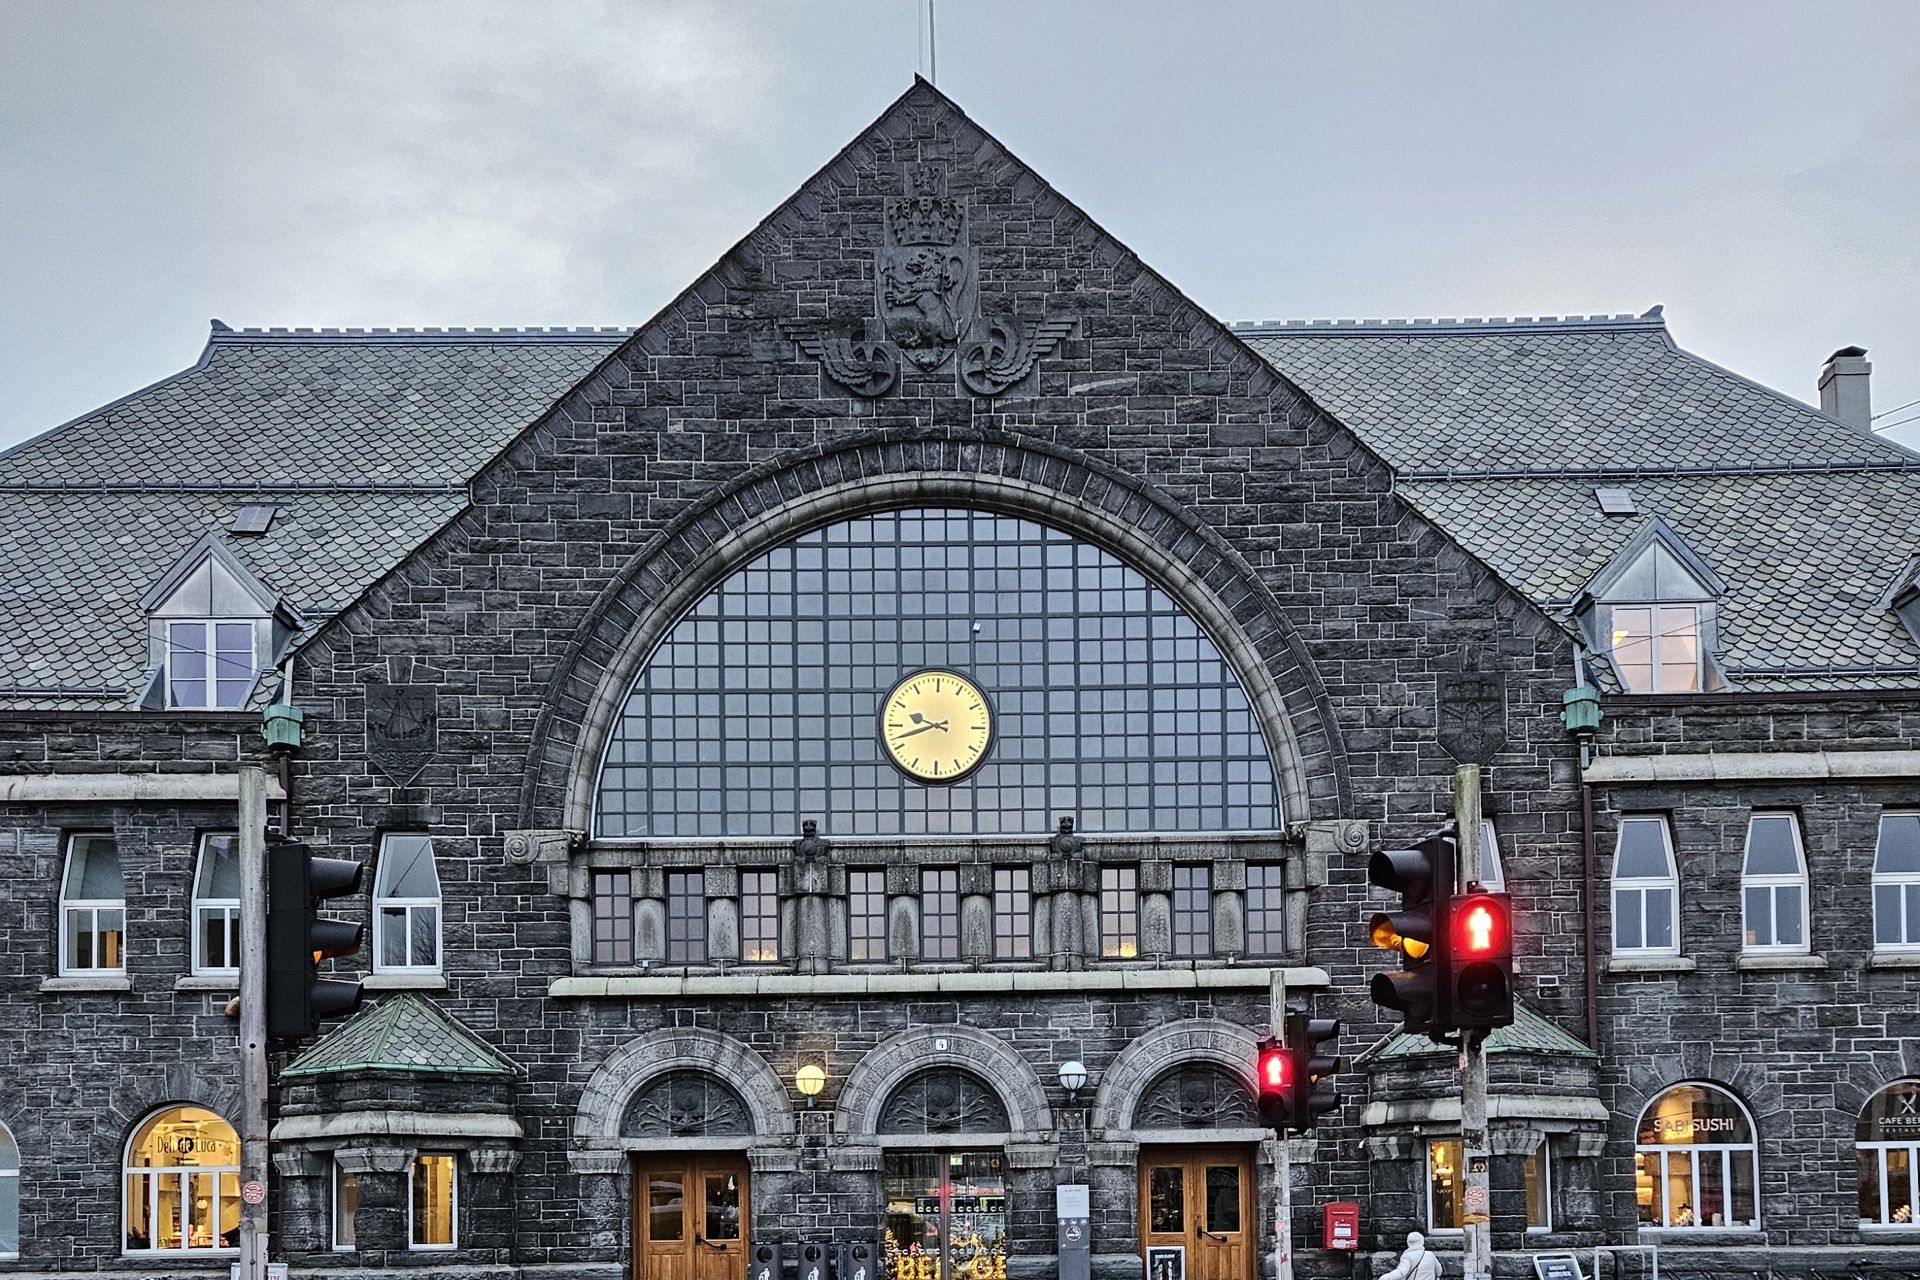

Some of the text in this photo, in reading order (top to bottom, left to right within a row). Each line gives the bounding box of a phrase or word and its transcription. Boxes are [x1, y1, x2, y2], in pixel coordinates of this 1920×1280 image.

[1653, 1117, 1734, 1132] SABI SUSHI
[1878, 1117, 1903, 1125] CAFE
[157, 1136, 217, 1154] Deli de Luca
